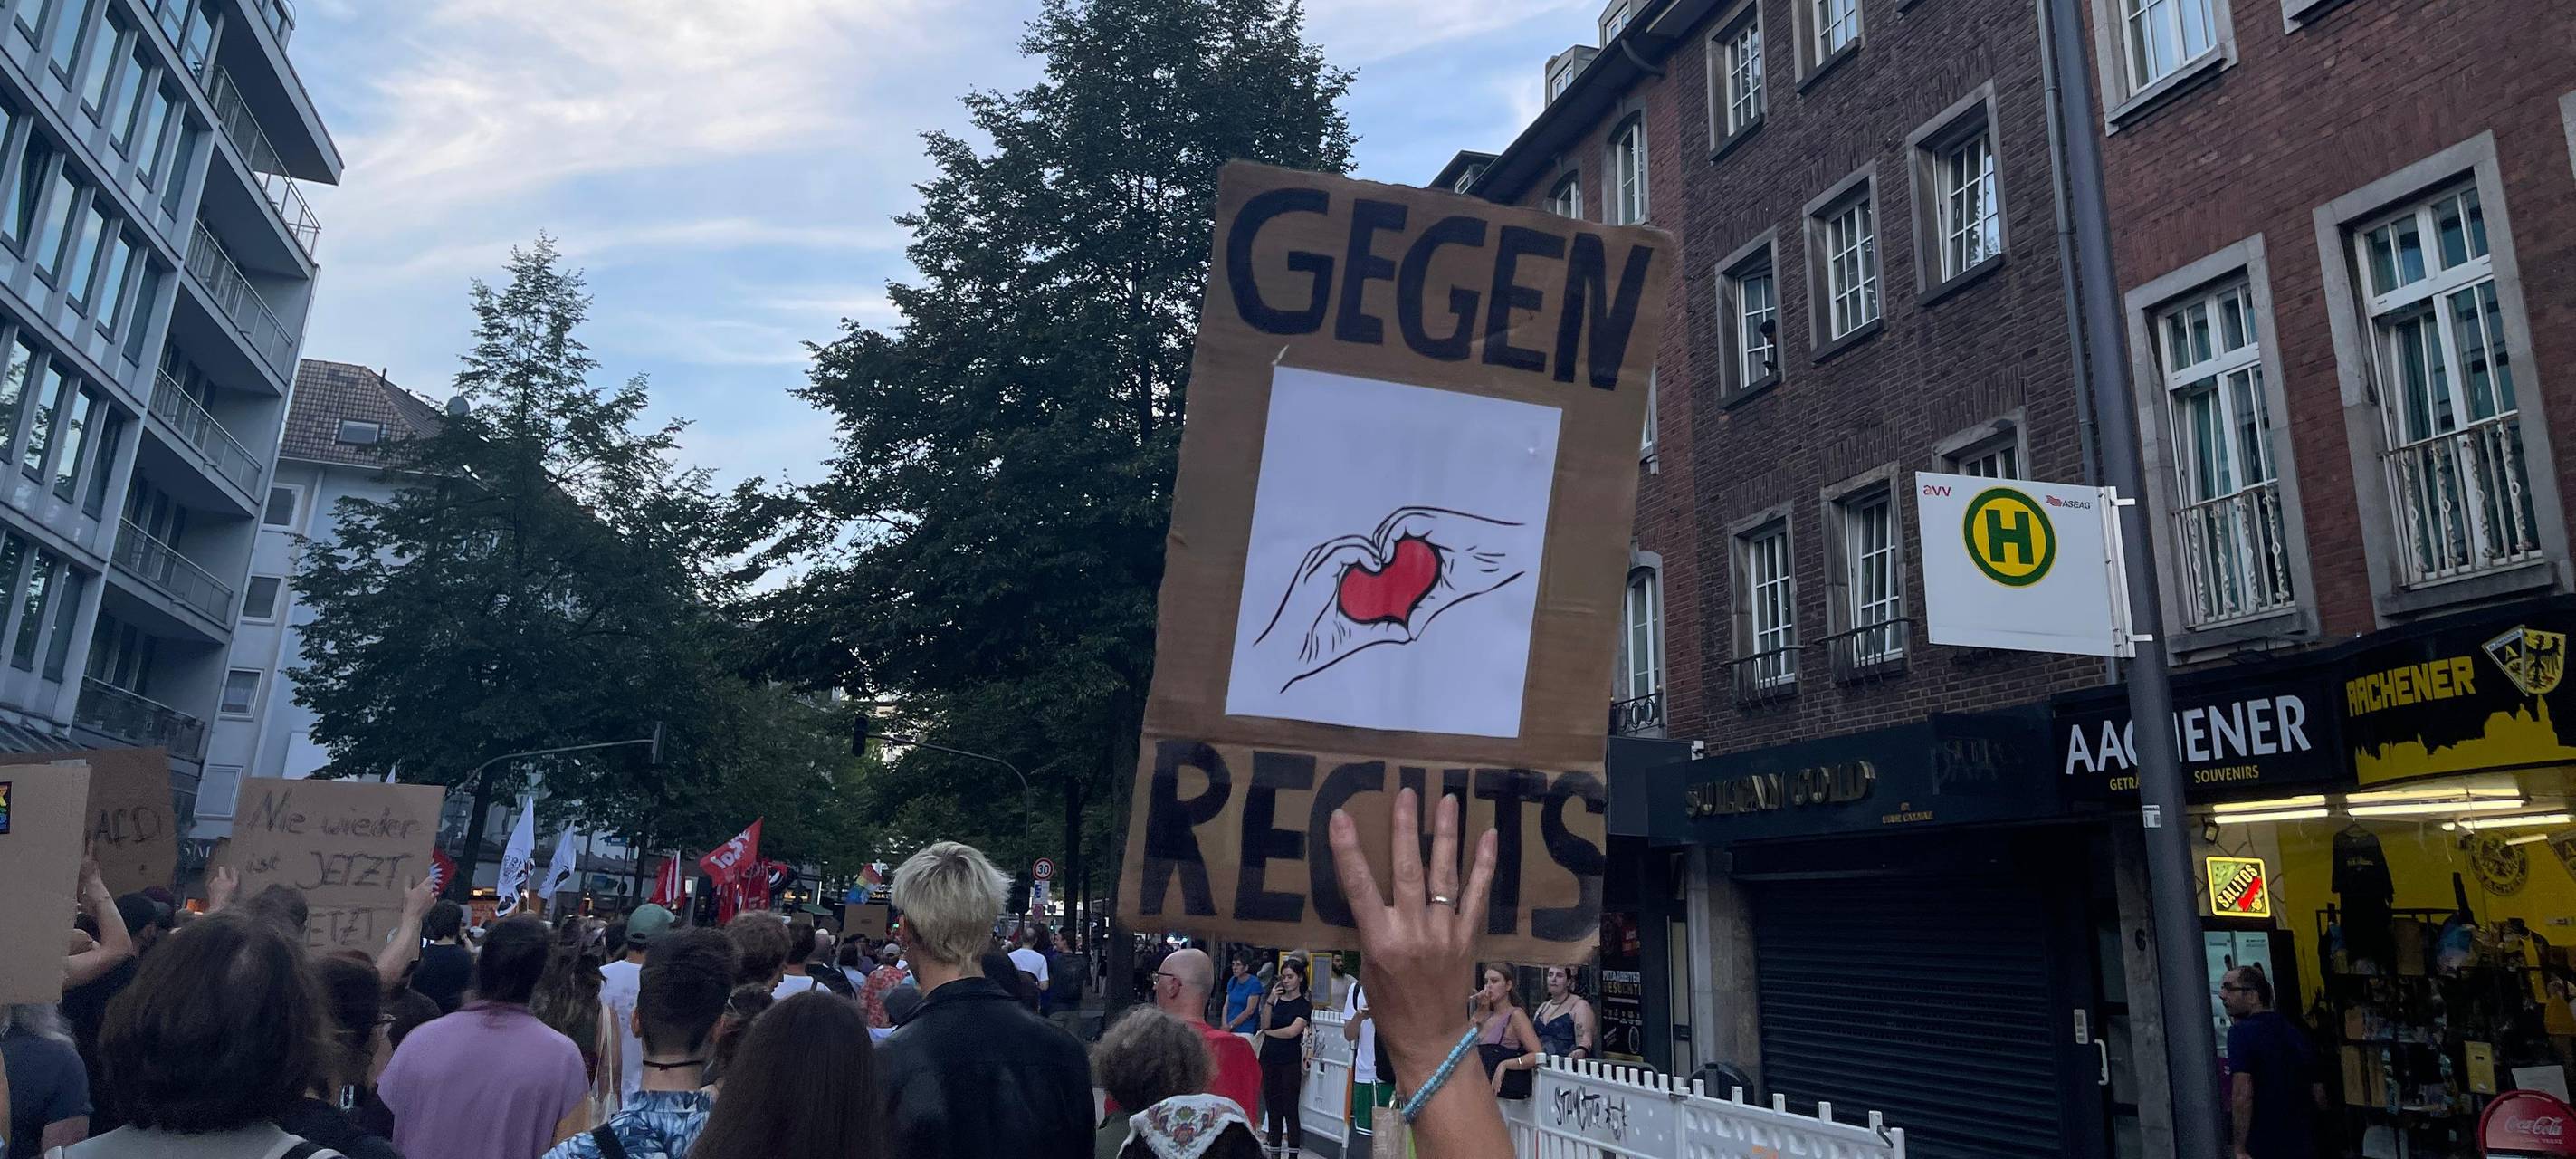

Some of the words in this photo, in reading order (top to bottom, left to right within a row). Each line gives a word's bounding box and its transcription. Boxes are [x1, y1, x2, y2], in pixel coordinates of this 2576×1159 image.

[1226, 187, 1654, 390] GEGEN
[2062, 500, 2091, 510] ASEAG
[1986, 509, 2034, 565] H
[2346, 655, 2476, 717] AACHENER
[2194, 764, 2260, 784] SOUVENIRS
[247, 788, 306, 834] Nie
[323, 806, 422, 838] wieder
[246, 853, 281, 873] ist
[295, 850, 415, 890] JETZT
[1037, 864, 1050, 875] 30
[2217, 864, 2258, 908] SALITOS
